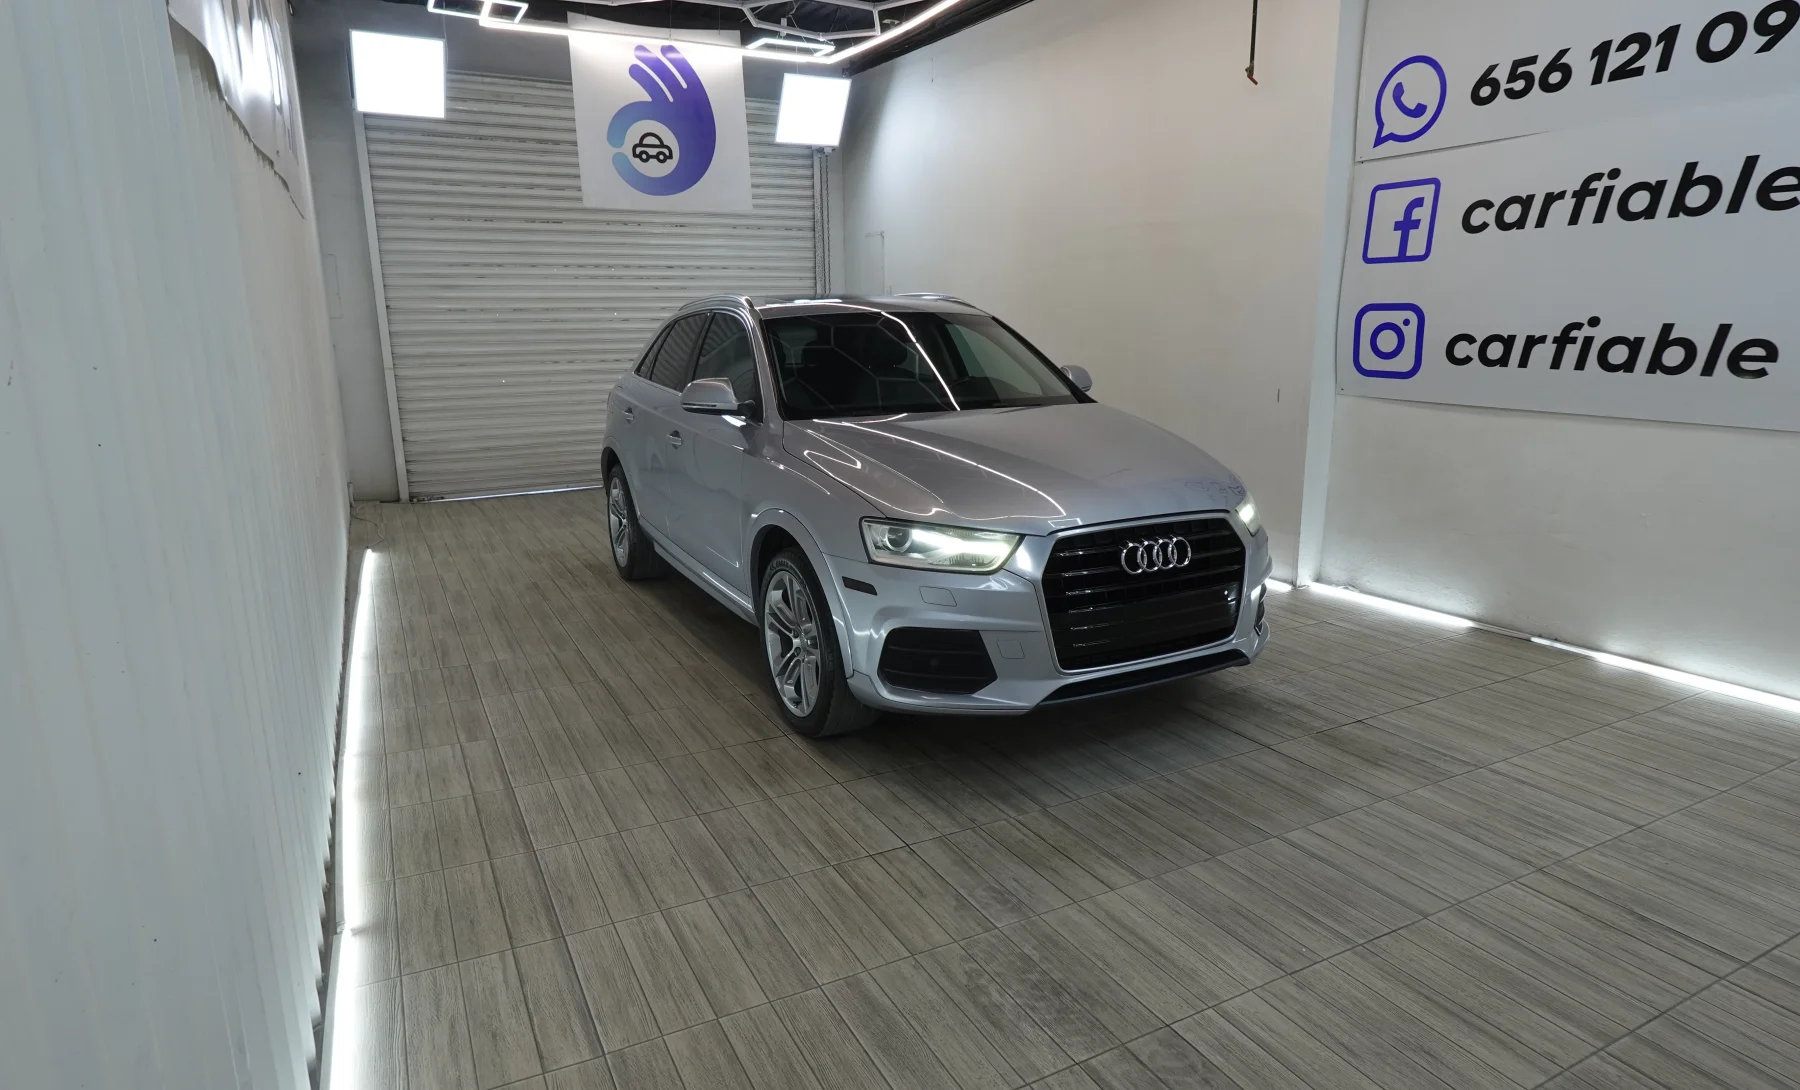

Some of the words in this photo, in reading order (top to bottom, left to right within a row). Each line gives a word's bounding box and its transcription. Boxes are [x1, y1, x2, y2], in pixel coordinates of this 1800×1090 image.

[1470, 48, 1573, 107] 656
[1589, 23, 1682, 86] 121
[1695, 0, 1800, 64] 09
[1461, 154, 1800, 235] carfiable
[1445, 315, 1779, 380] carfiable
